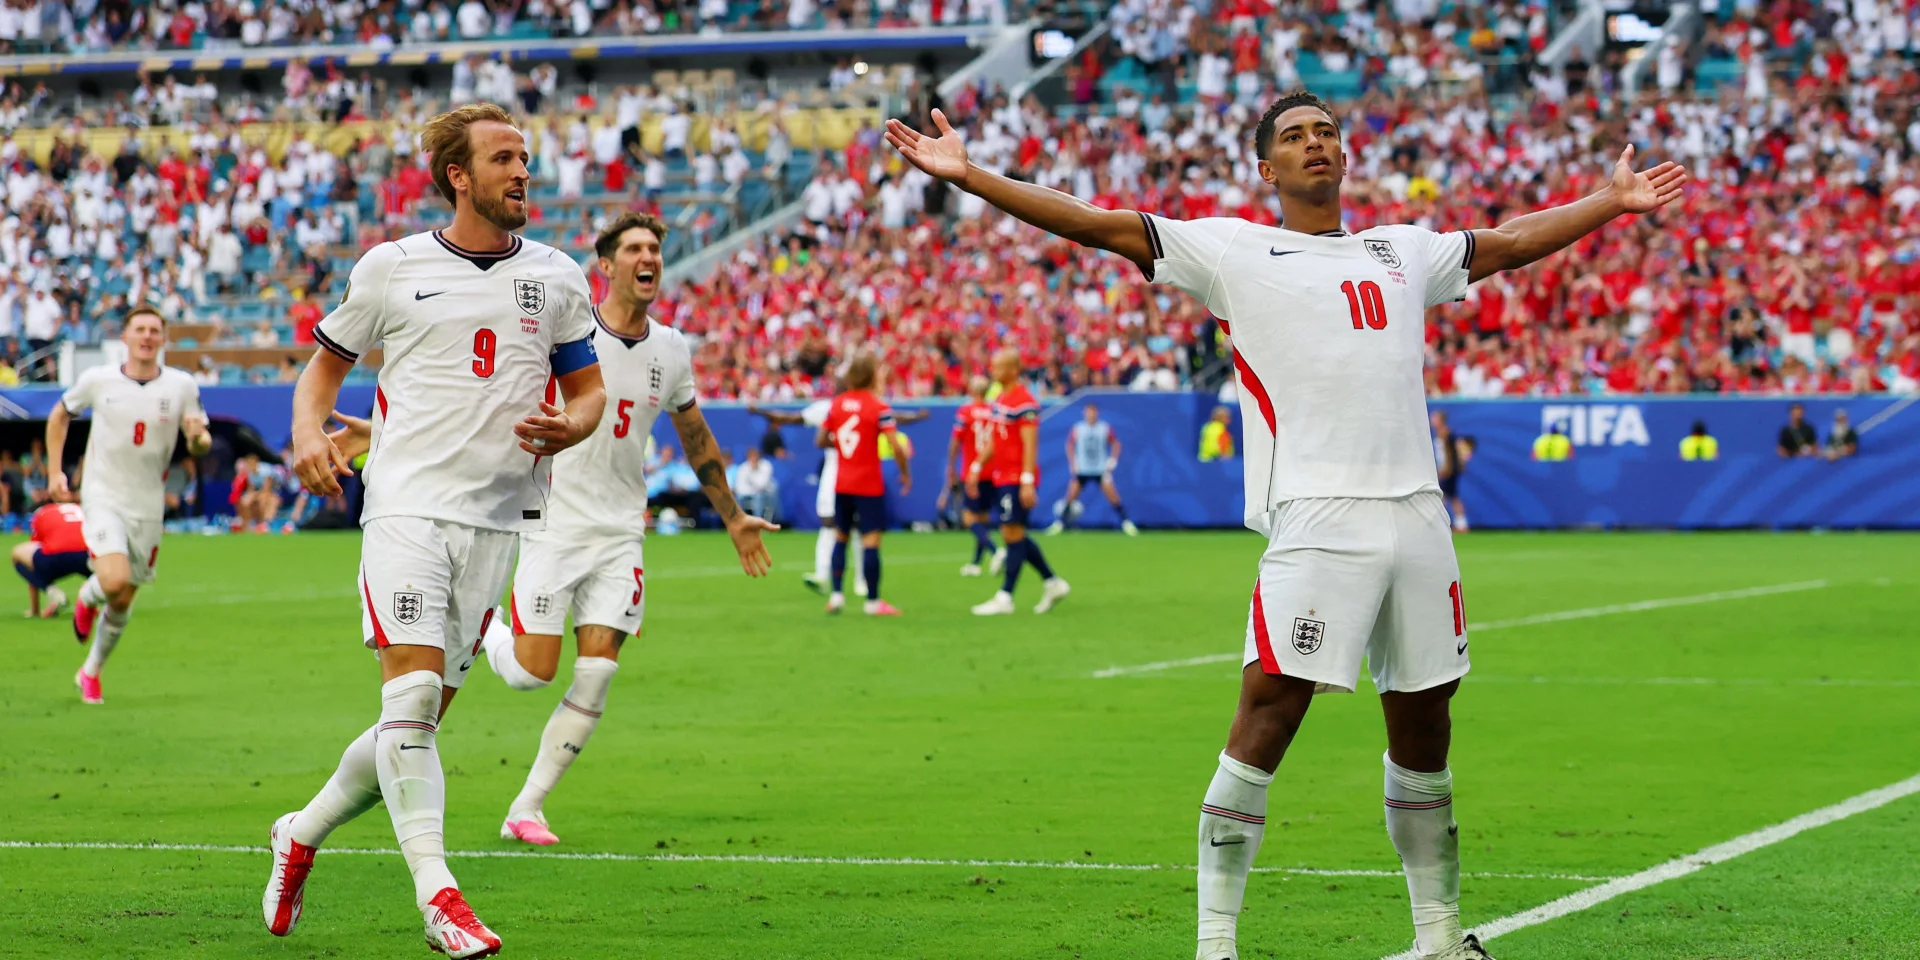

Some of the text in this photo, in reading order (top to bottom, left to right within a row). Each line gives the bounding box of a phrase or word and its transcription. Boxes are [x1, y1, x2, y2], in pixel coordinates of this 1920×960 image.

[1340, 280, 1388, 330] 10
[472, 327, 497, 379] 9
[133, 420, 146, 446] 8
[613, 398, 635, 439] 5
[836, 413, 861, 459] 6
[1541, 404, 1652, 446] FIFA
[1448, 580, 1467, 637] 1
